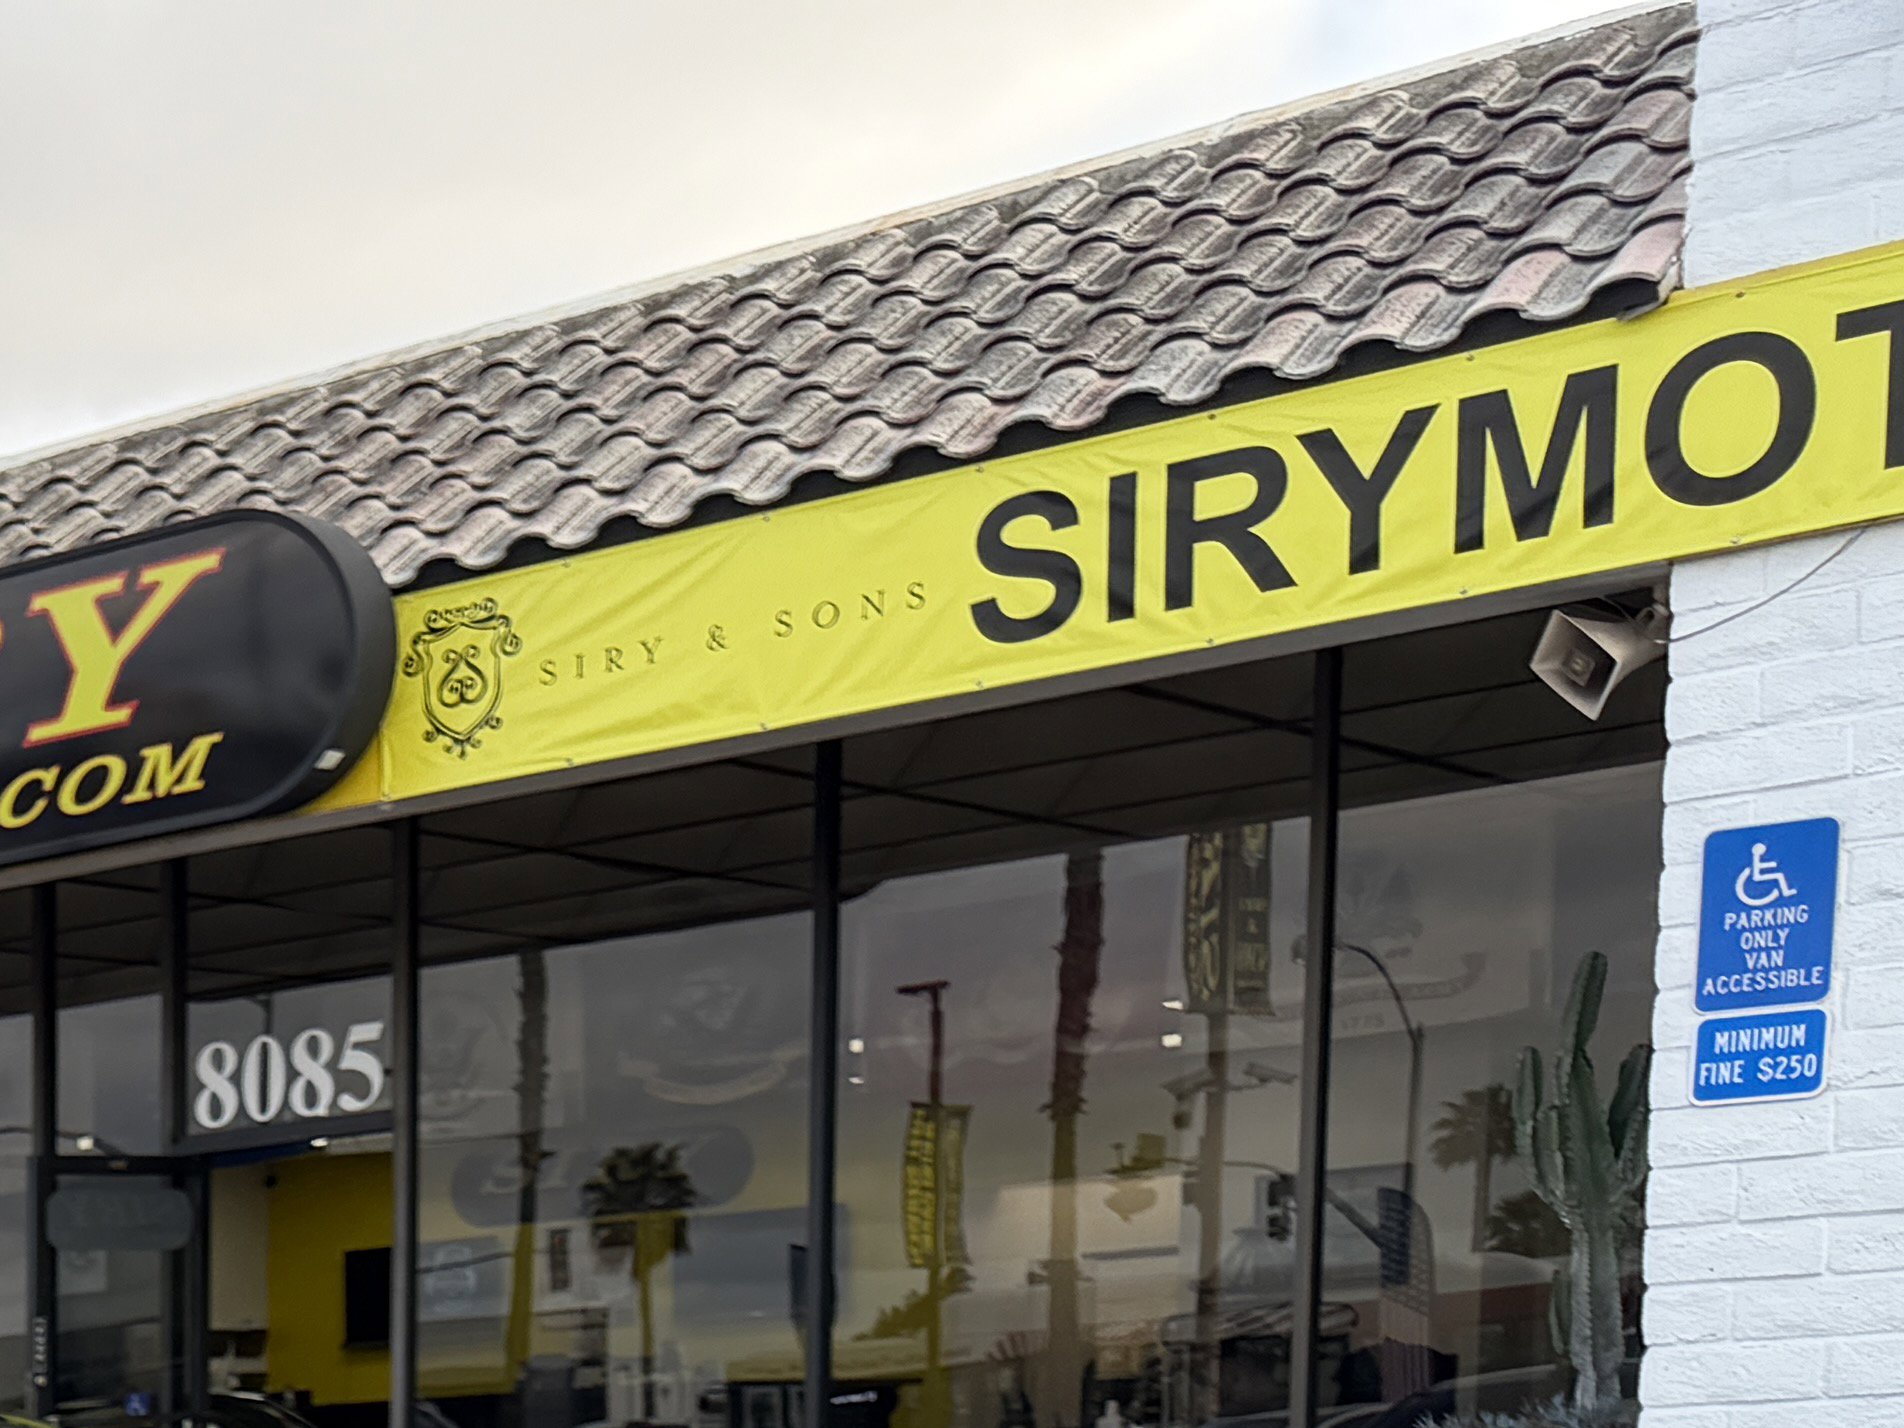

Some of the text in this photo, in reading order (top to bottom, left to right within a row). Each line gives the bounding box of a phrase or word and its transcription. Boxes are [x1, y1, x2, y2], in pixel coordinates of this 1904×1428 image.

[538, 581, 927, 686] SIRY & SONS
[1723, 904, 1809, 931] PARKING
[1740, 928, 1790, 950] ONLY
[1745, 950, 1784, 970] VAN
[1702, 966, 1824, 996] ACCESSIBLE
[1714, 1024, 1807, 1055] MINIMUM
[194, 1019, 387, 1131] 8085
[1699, 1053, 1817, 1087] FINE $250
